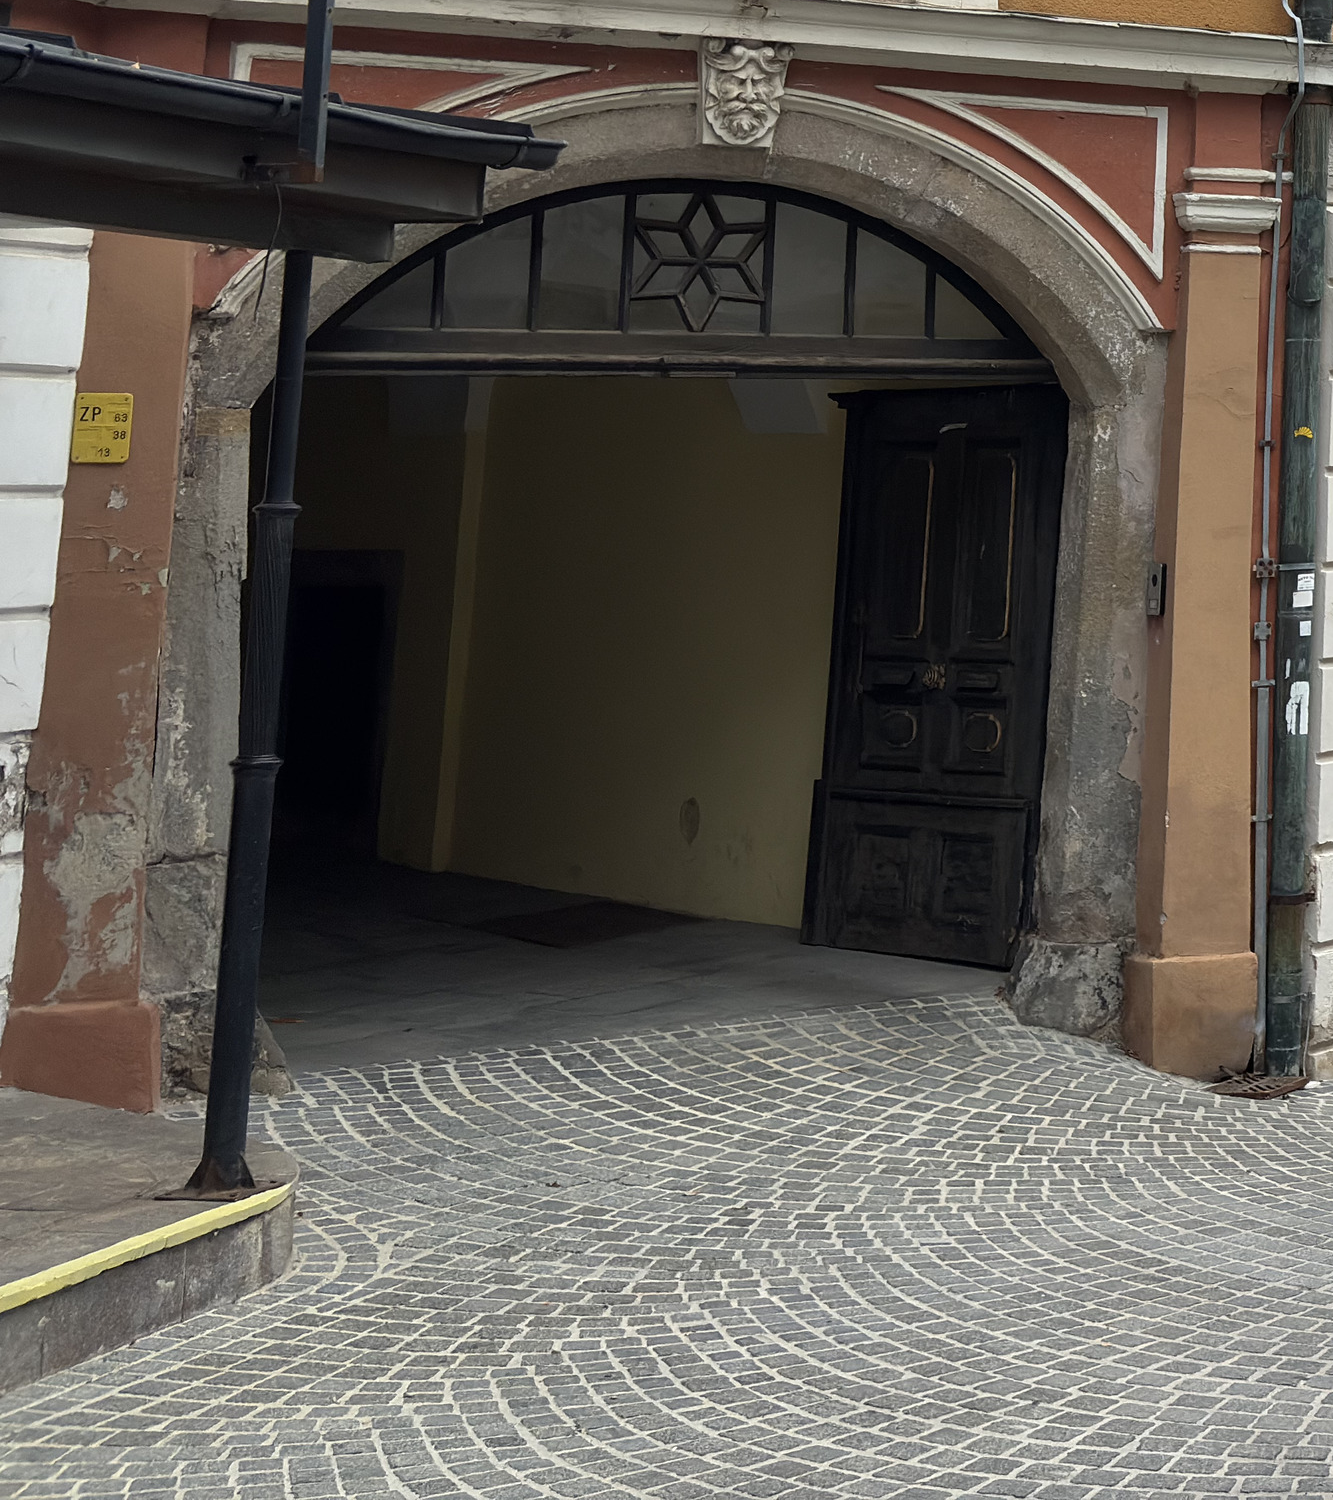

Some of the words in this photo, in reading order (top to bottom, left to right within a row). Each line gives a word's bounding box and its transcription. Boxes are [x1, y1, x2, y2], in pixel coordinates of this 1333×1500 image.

[79, 406, 101, 422] ZP
[113, 430, 126, 440] 38
[98, 447, 110, 457] 13
